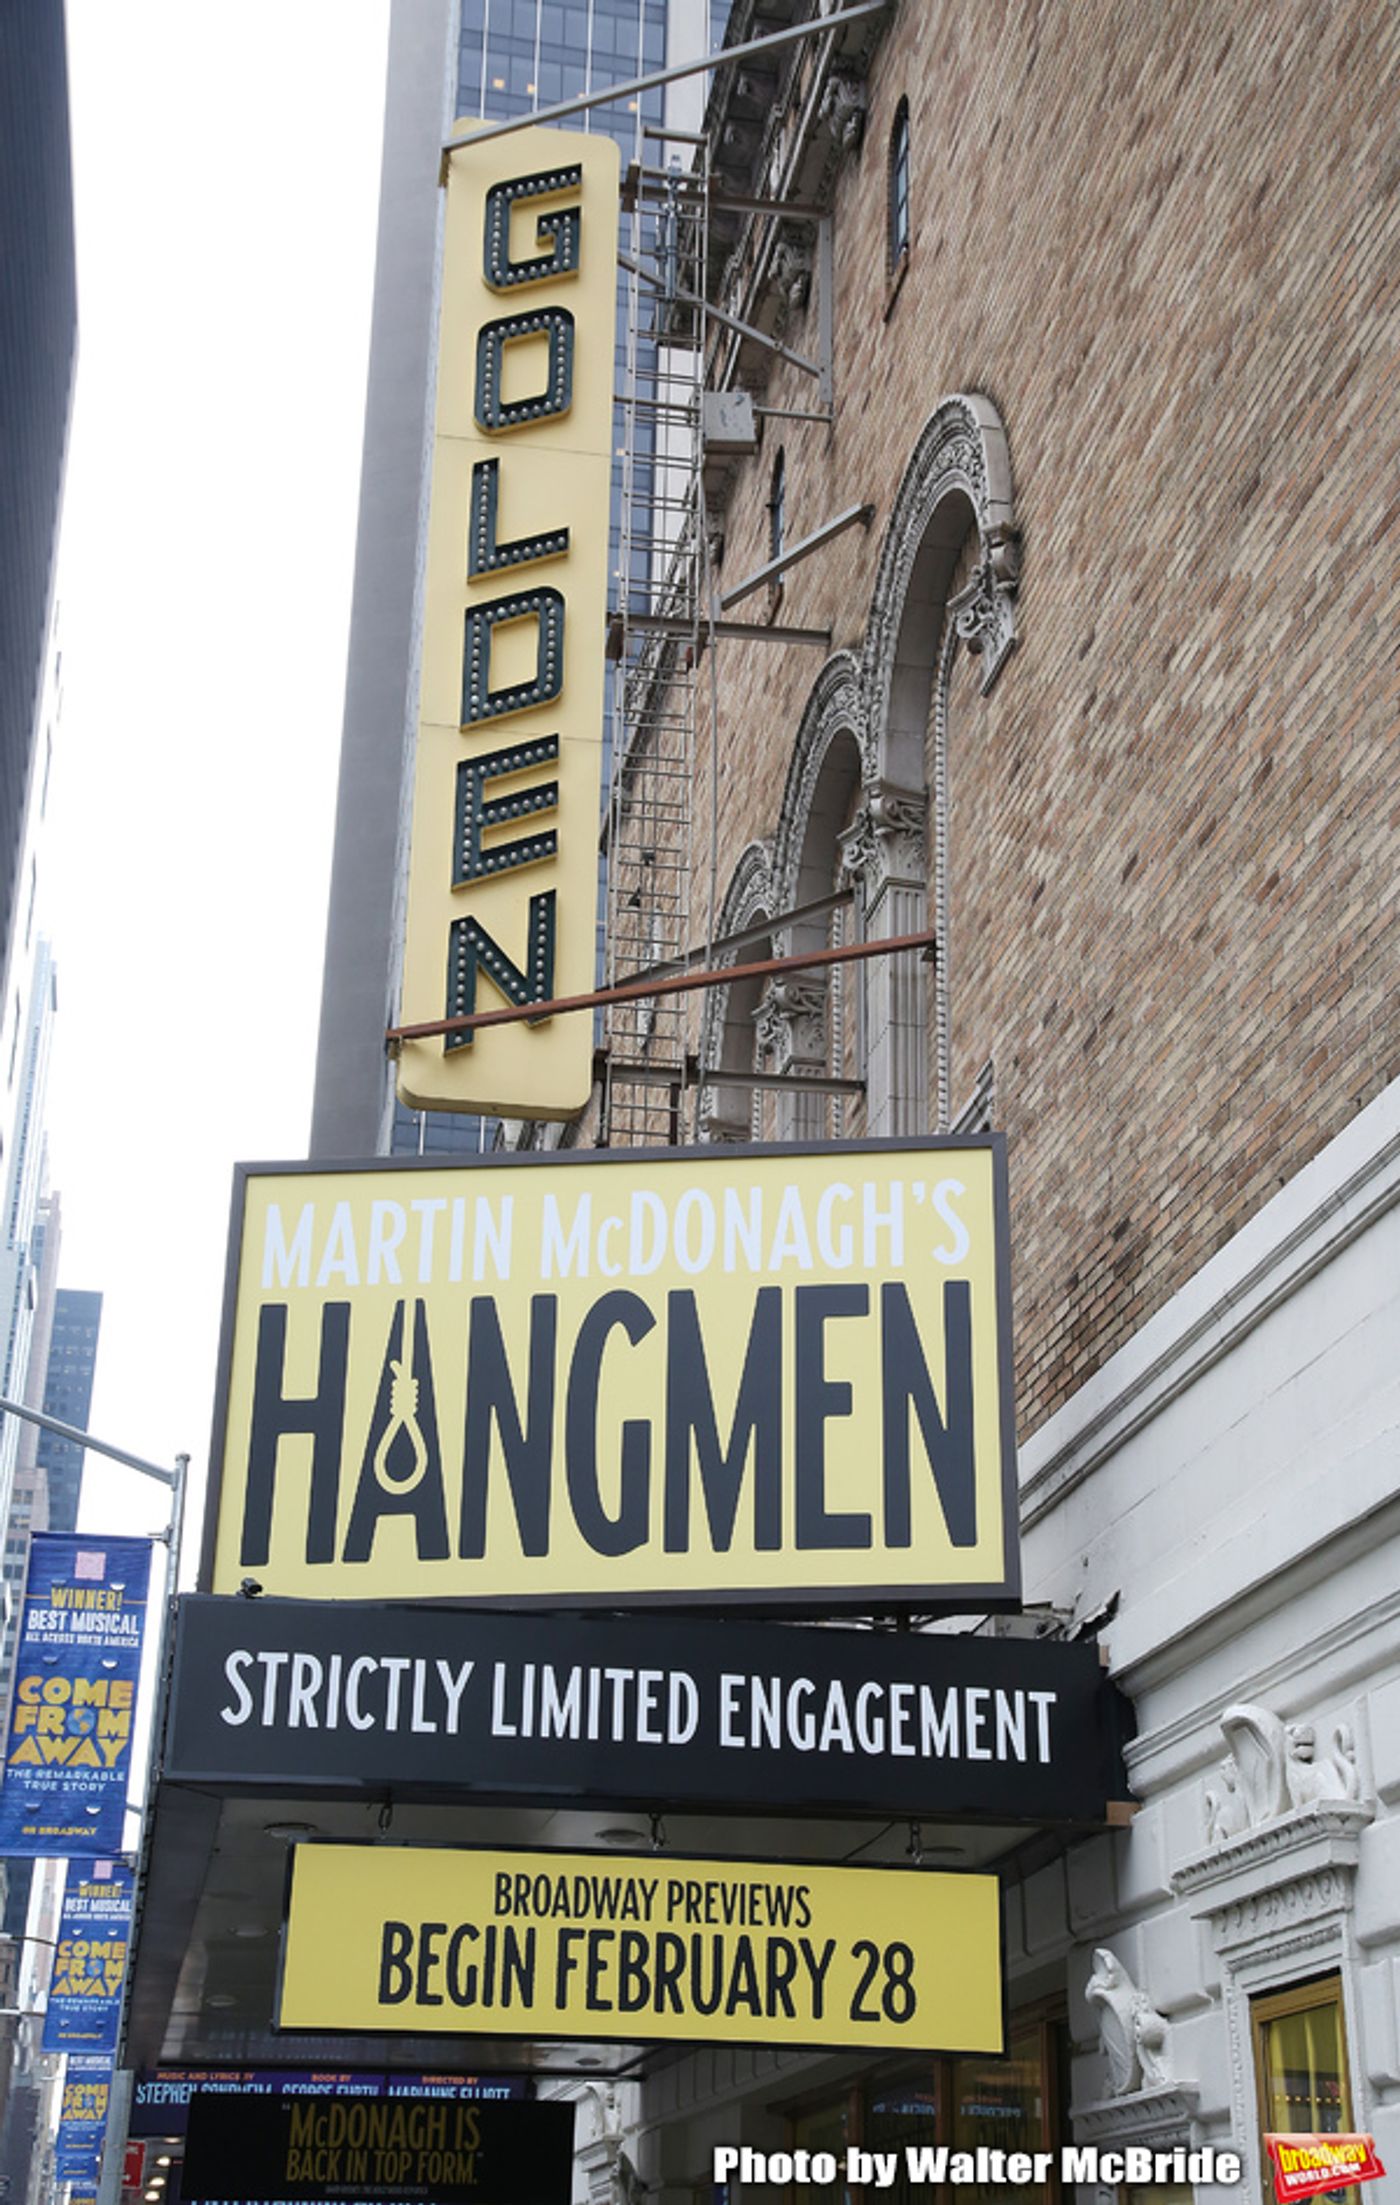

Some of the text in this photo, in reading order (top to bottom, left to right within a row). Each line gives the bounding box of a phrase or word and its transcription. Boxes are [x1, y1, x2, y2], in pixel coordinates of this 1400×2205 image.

[443, 162, 582, 1058] GOLDEN
[260, 1178, 972, 1290] MARTIN McDONAGH'S
[239, 1279, 978, 1567] HANGMEN
[51, 1587, 123, 1611] WINNER!
[28, 1609, 139, 1635] BEST MUSICAL
[18, 1675, 133, 1708] COME
[219, 1649, 1058, 1765] STRICTLY LIMITED ENGAGEMENT
[14, 1705, 131, 1738] FROM
[7, 1735, 128, 1768] AWAY
[6, 1768, 125, 1782] THE REMARKABLE
[23, 1780, 106, 1792] TRUE STORY
[39, 1826, 97, 1836] BROADWAY
[65, 1898, 131, 1913] BEST MUSICAL
[494, 1871, 812, 1929] BROADWAY PREVIEWS
[58, 1940, 127, 1959] COME
[55, 1957, 125, 1979] FROM
[377, 1920, 918, 2025] BEGIN FEBRUARY 28
[52, 1977, 122, 1996] AWAY
[188, 2072, 208, 2080] AND
[210, 2072, 240, 2081] LYRICS
[311, 2074, 352, 2083] BOOK BY
[422, 2076, 479, 2085] DIRECTED BY
[65, 2084, 109, 2096] COME
[61, 2108, 105, 2120] AWAY
[454, 2106, 481, 2151] IS
[286, 2149, 340, 2182] BACK
[345, 2151, 368, 2182] IN
[373, 2151, 413, 2184] TOP
